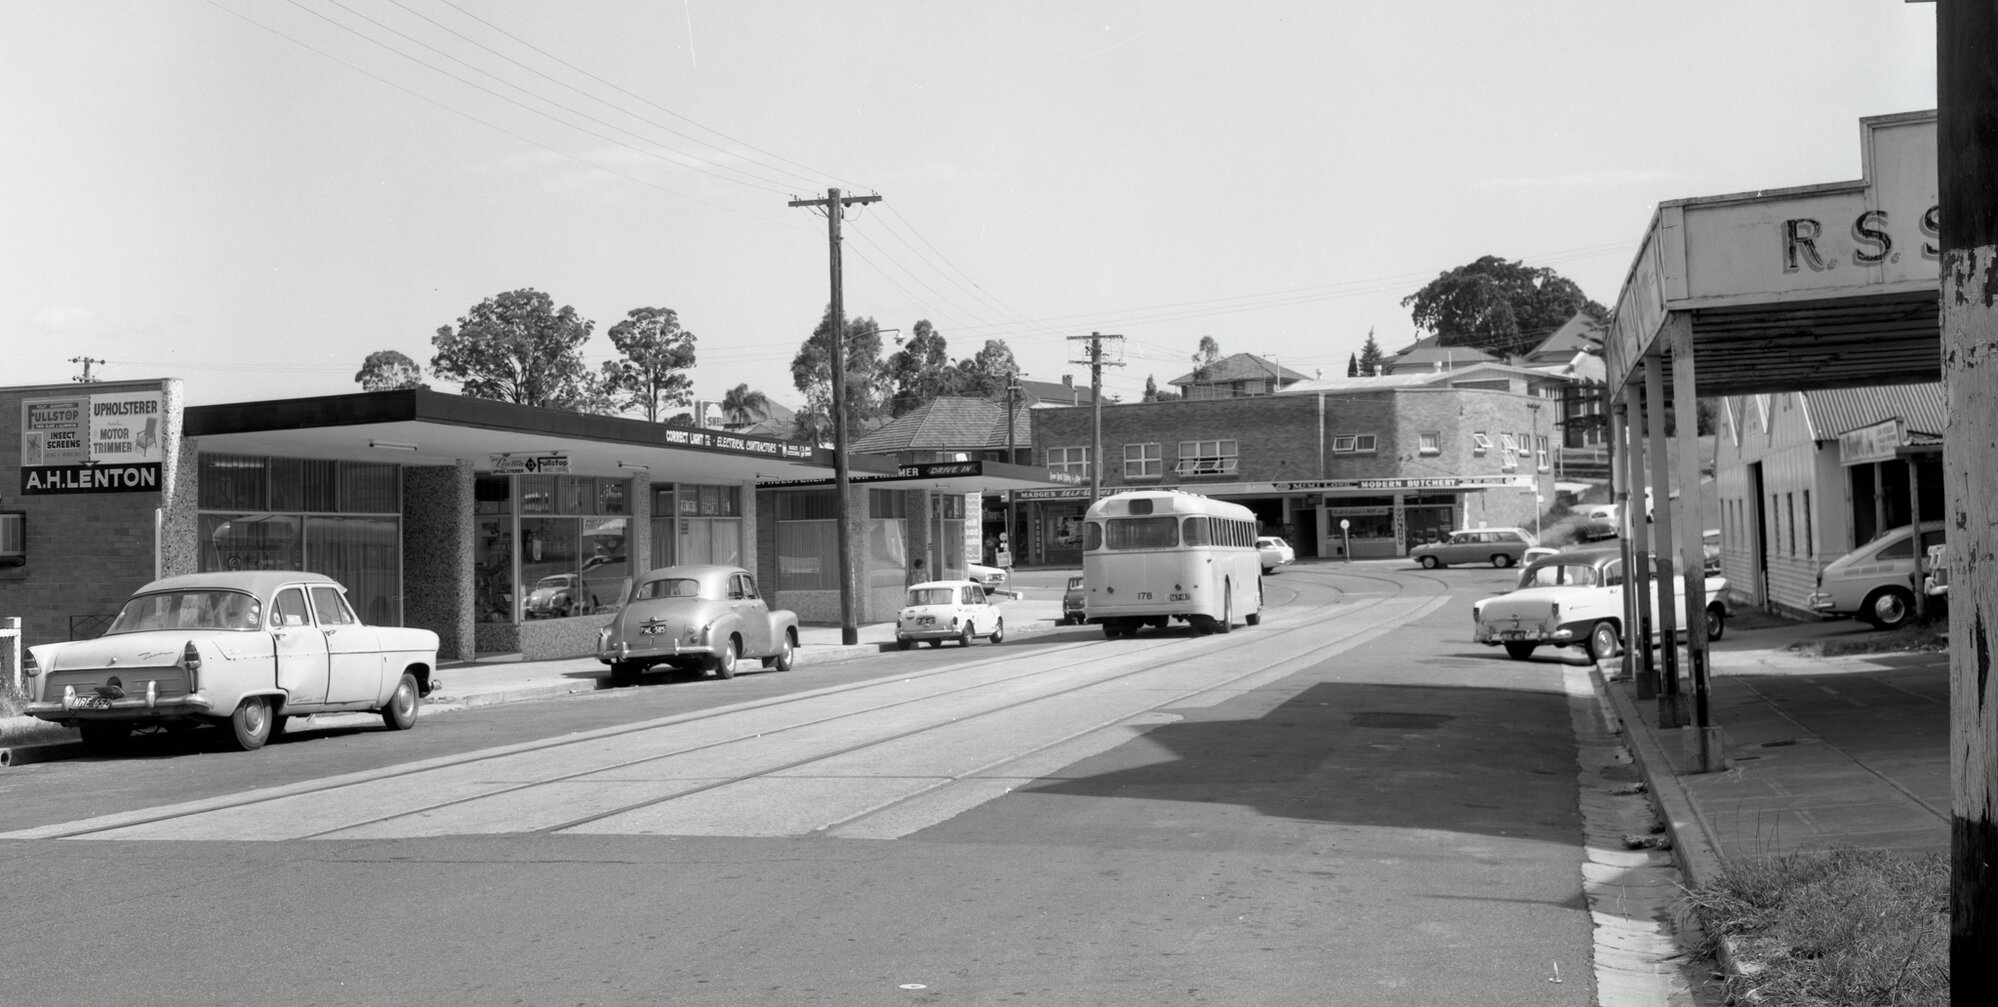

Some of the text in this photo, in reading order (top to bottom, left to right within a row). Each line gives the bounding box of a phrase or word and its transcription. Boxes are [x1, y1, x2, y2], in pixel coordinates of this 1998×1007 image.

[94, 400, 158, 417] UPHOLSTERER
[28, 404, 79, 429] FULLSTOP
[50, 431, 76, 440] INSECT
[100, 428, 129, 440] MOTOR
[666, 430, 688, 443] CORRECT
[47, 440, 80, 449] SCREENS
[93, 442, 132, 454] TRIMMER
[716, 436, 745, 450] ELECTRICAL
[930, 465, 972, 474] DRIVE IN
[1407, 479, 1457, 487] BUTCHERY
[1137, 592, 1153, 600] 178
